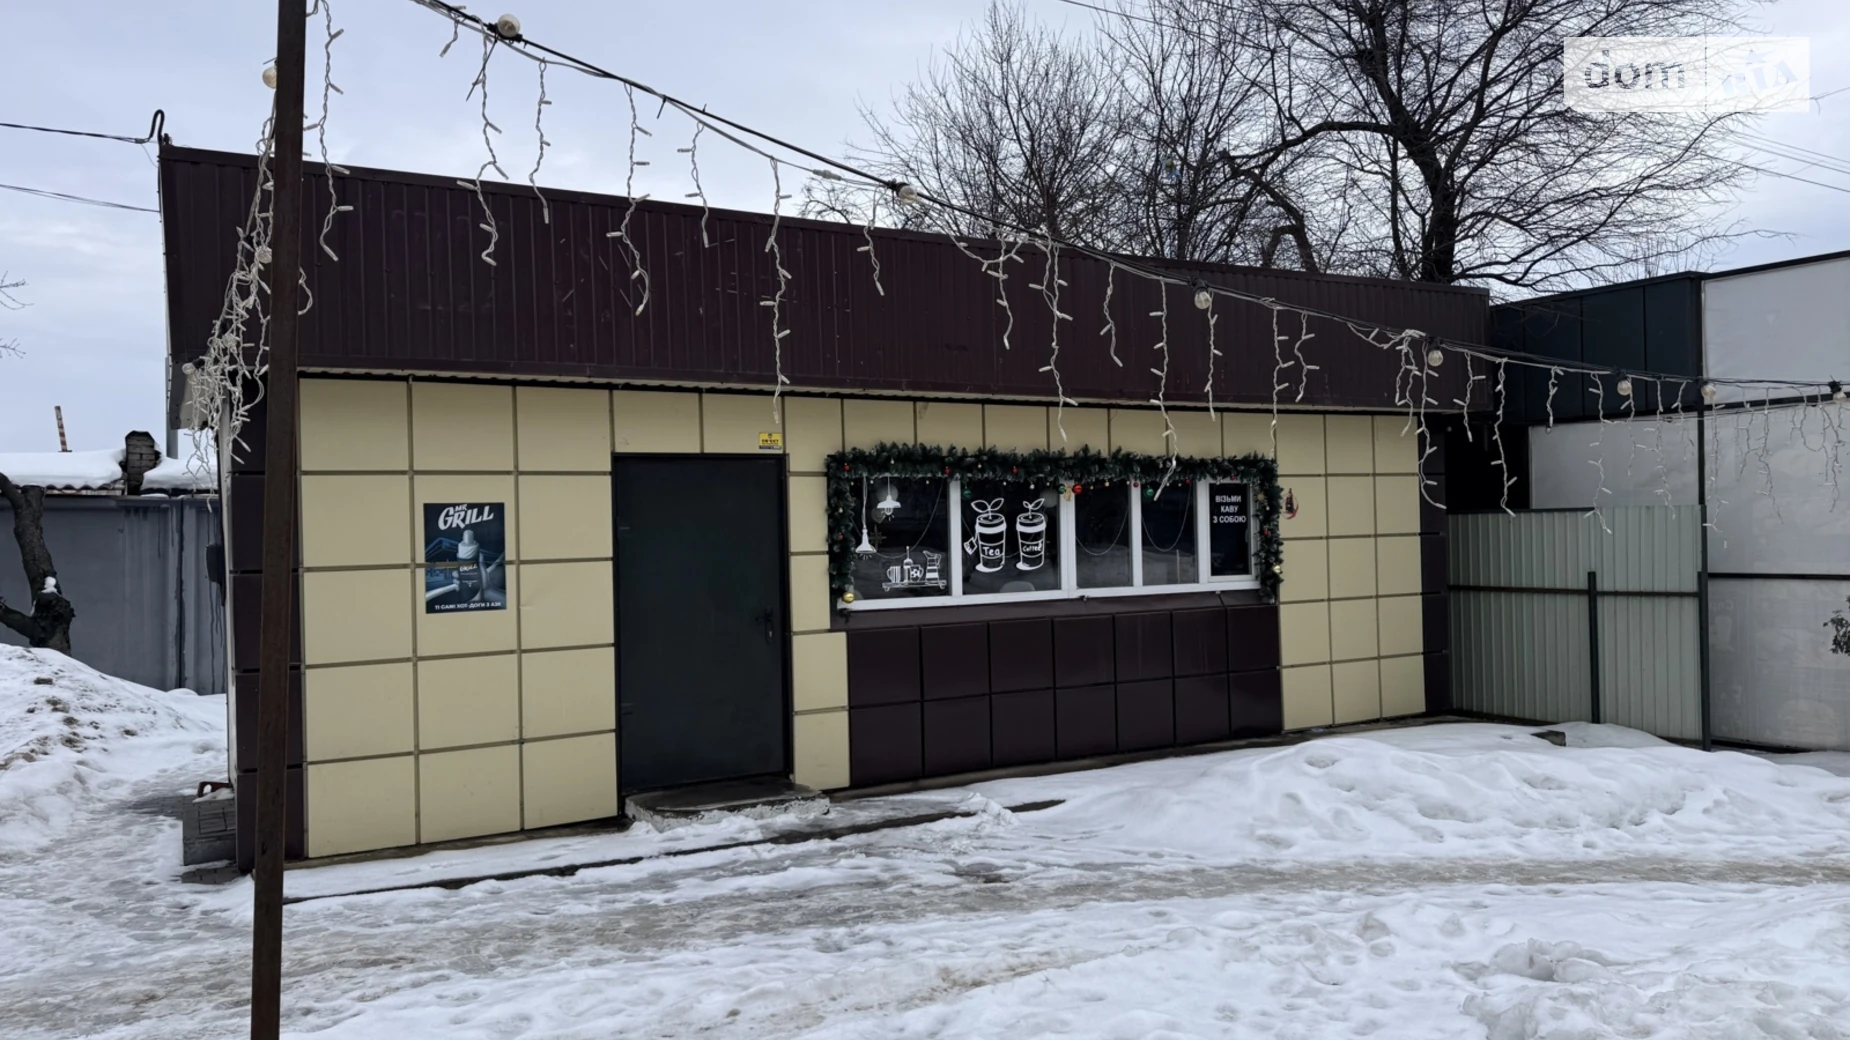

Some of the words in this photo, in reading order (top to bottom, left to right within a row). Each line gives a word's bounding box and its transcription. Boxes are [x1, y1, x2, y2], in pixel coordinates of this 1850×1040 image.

[1215, 494, 1242, 503] ВІЗЬМИ
[1220, 505, 1239, 513] КАВУ
[438, 505, 494, 531] GRILL
[1219, 515, 1247, 523] СОБОЮ
[982, 546, 1000, 556] Tea
[1022, 544, 1042, 553] Coffee
